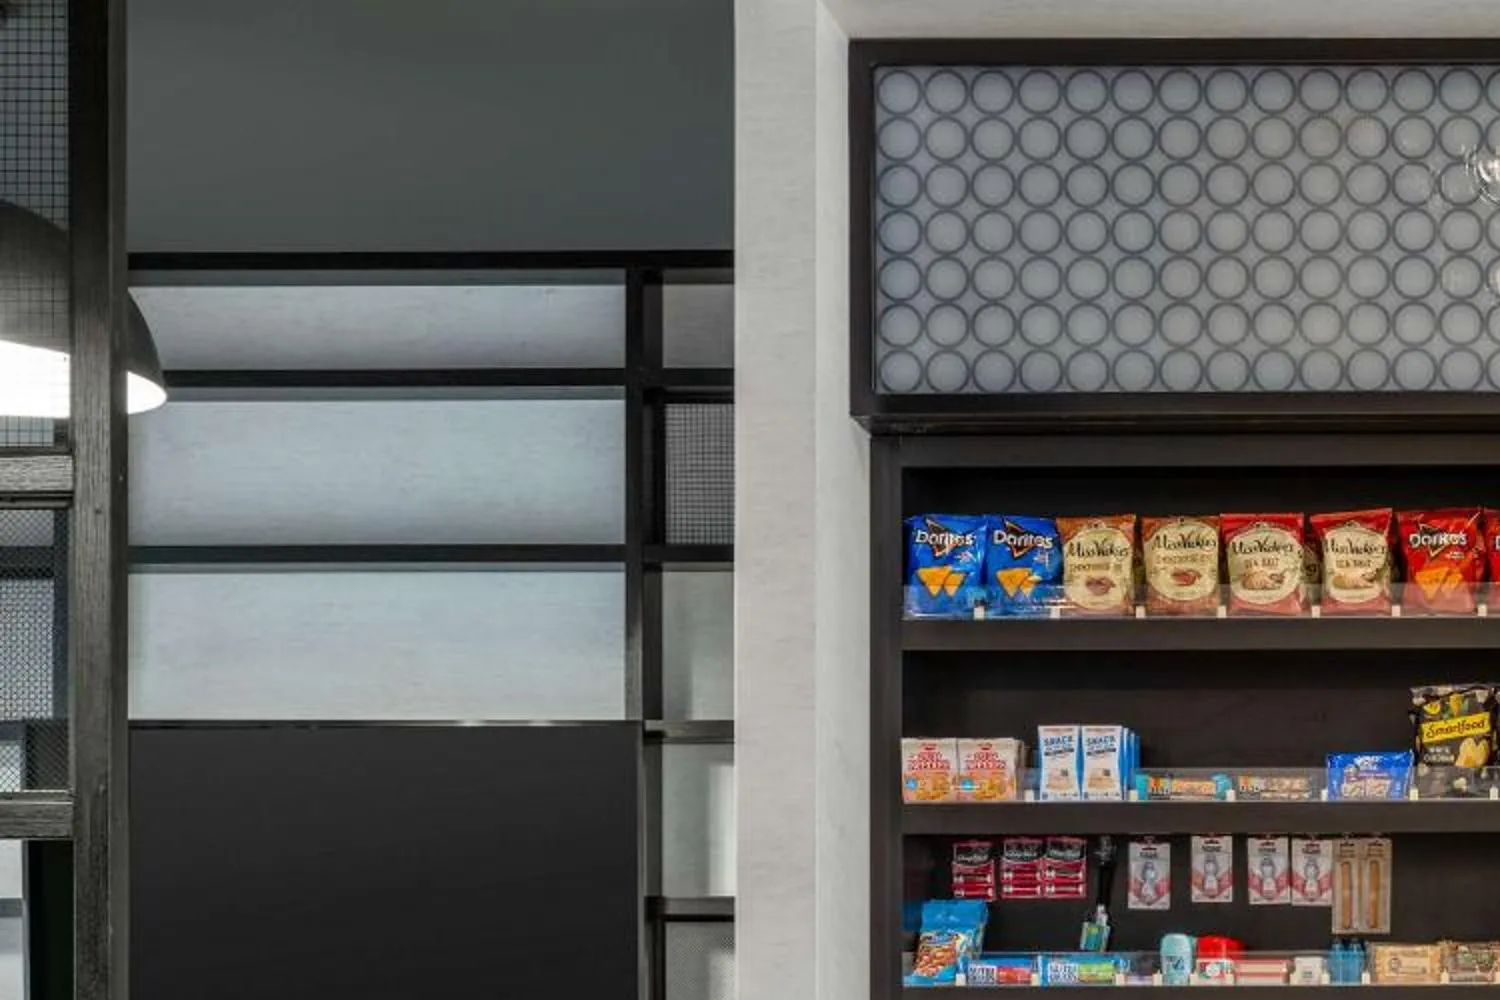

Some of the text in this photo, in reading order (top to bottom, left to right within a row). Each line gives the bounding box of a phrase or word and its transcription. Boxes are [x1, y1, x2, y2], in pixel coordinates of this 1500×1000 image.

[914, 529, 976, 548] Doritos
[993, 530, 1052, 549] Doritos
[1409, 532, 1467, 549] Doritos
